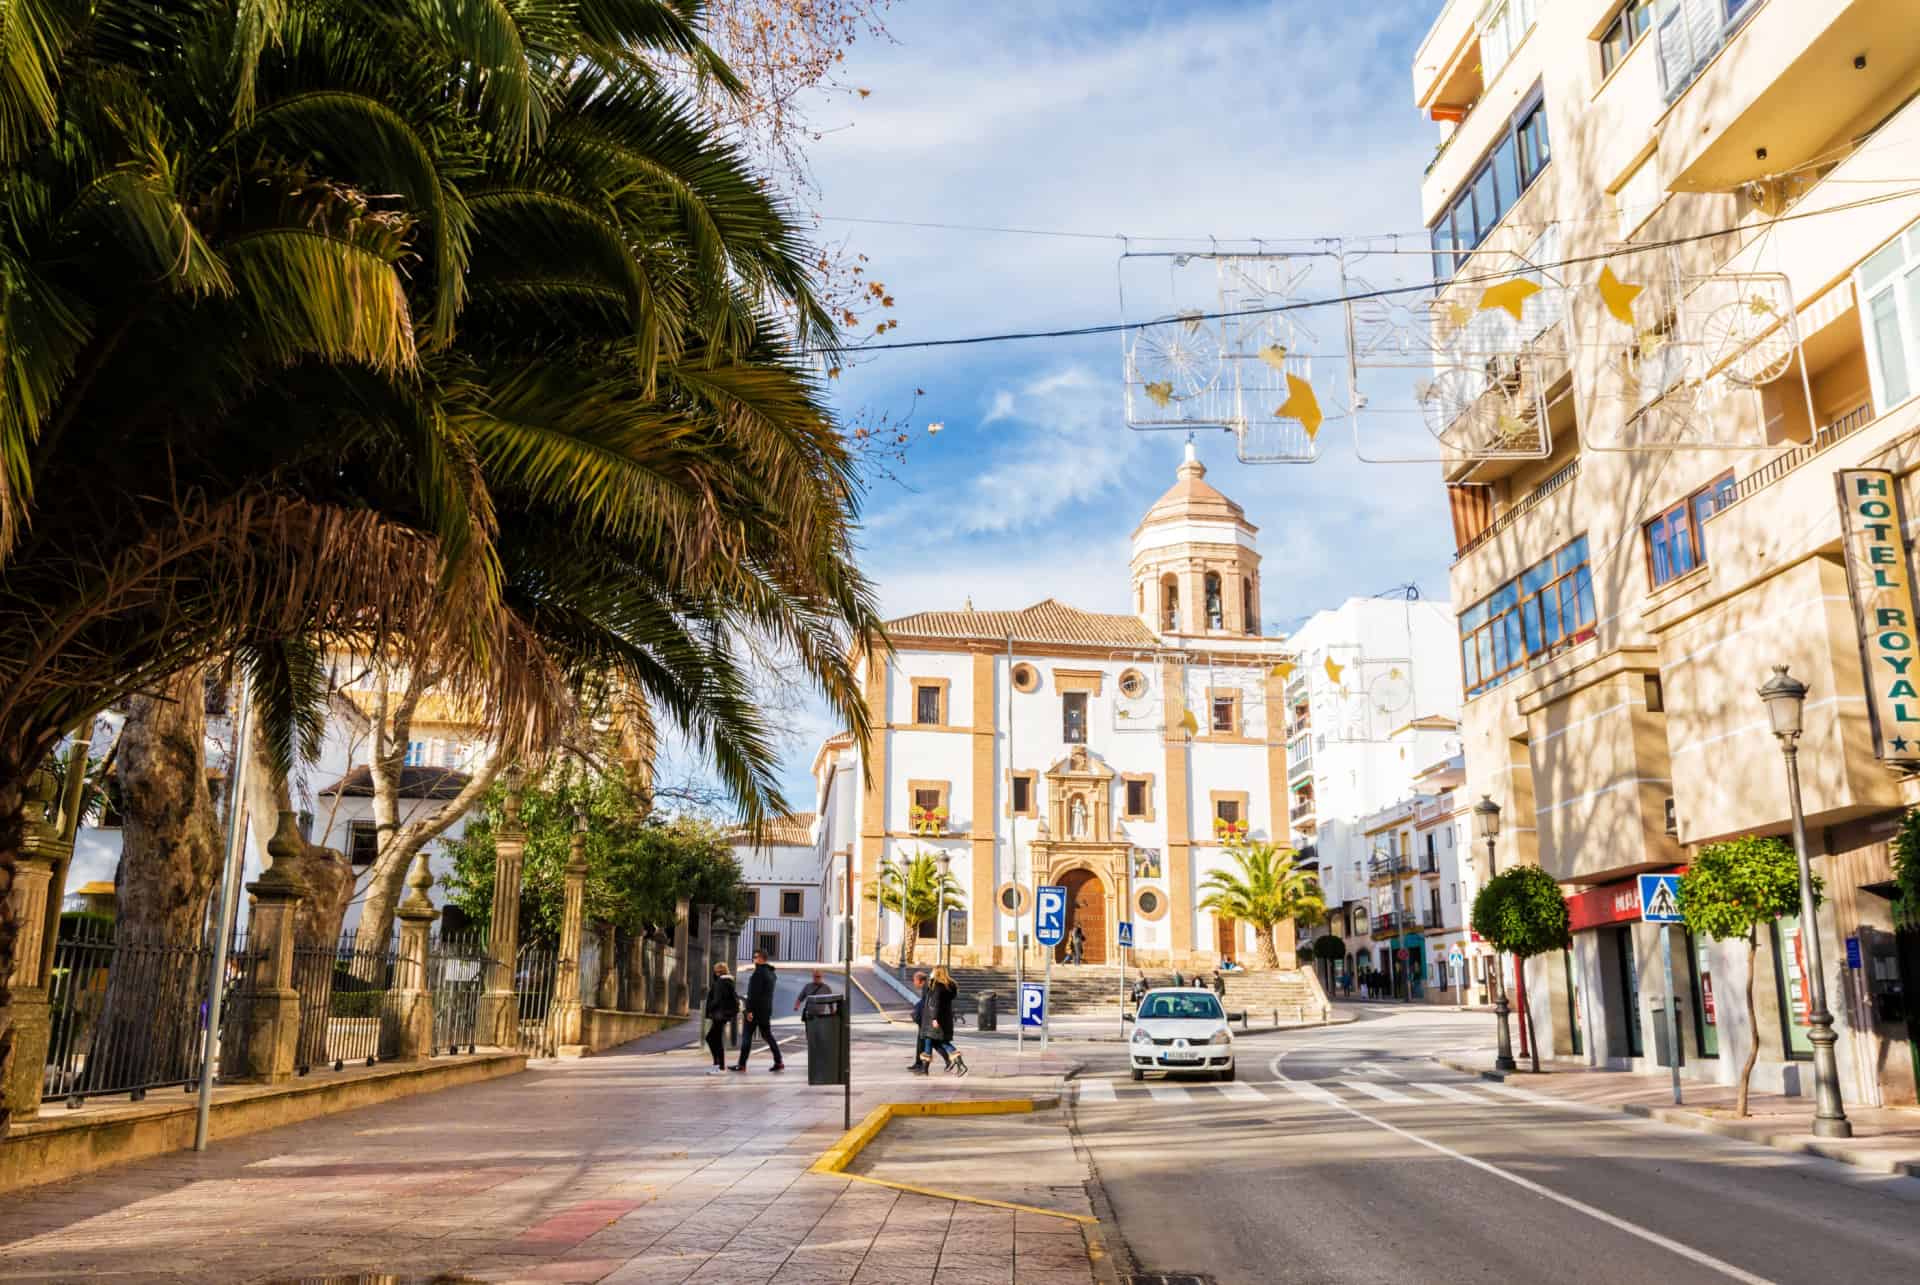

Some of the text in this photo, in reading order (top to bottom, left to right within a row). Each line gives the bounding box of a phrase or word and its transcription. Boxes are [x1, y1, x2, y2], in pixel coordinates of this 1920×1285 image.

[1856, 478, 1920, 722] HOTEL ROYAL
[1038, 893, 1062, 927] P
[1023, 990, 1042, 1018] P
